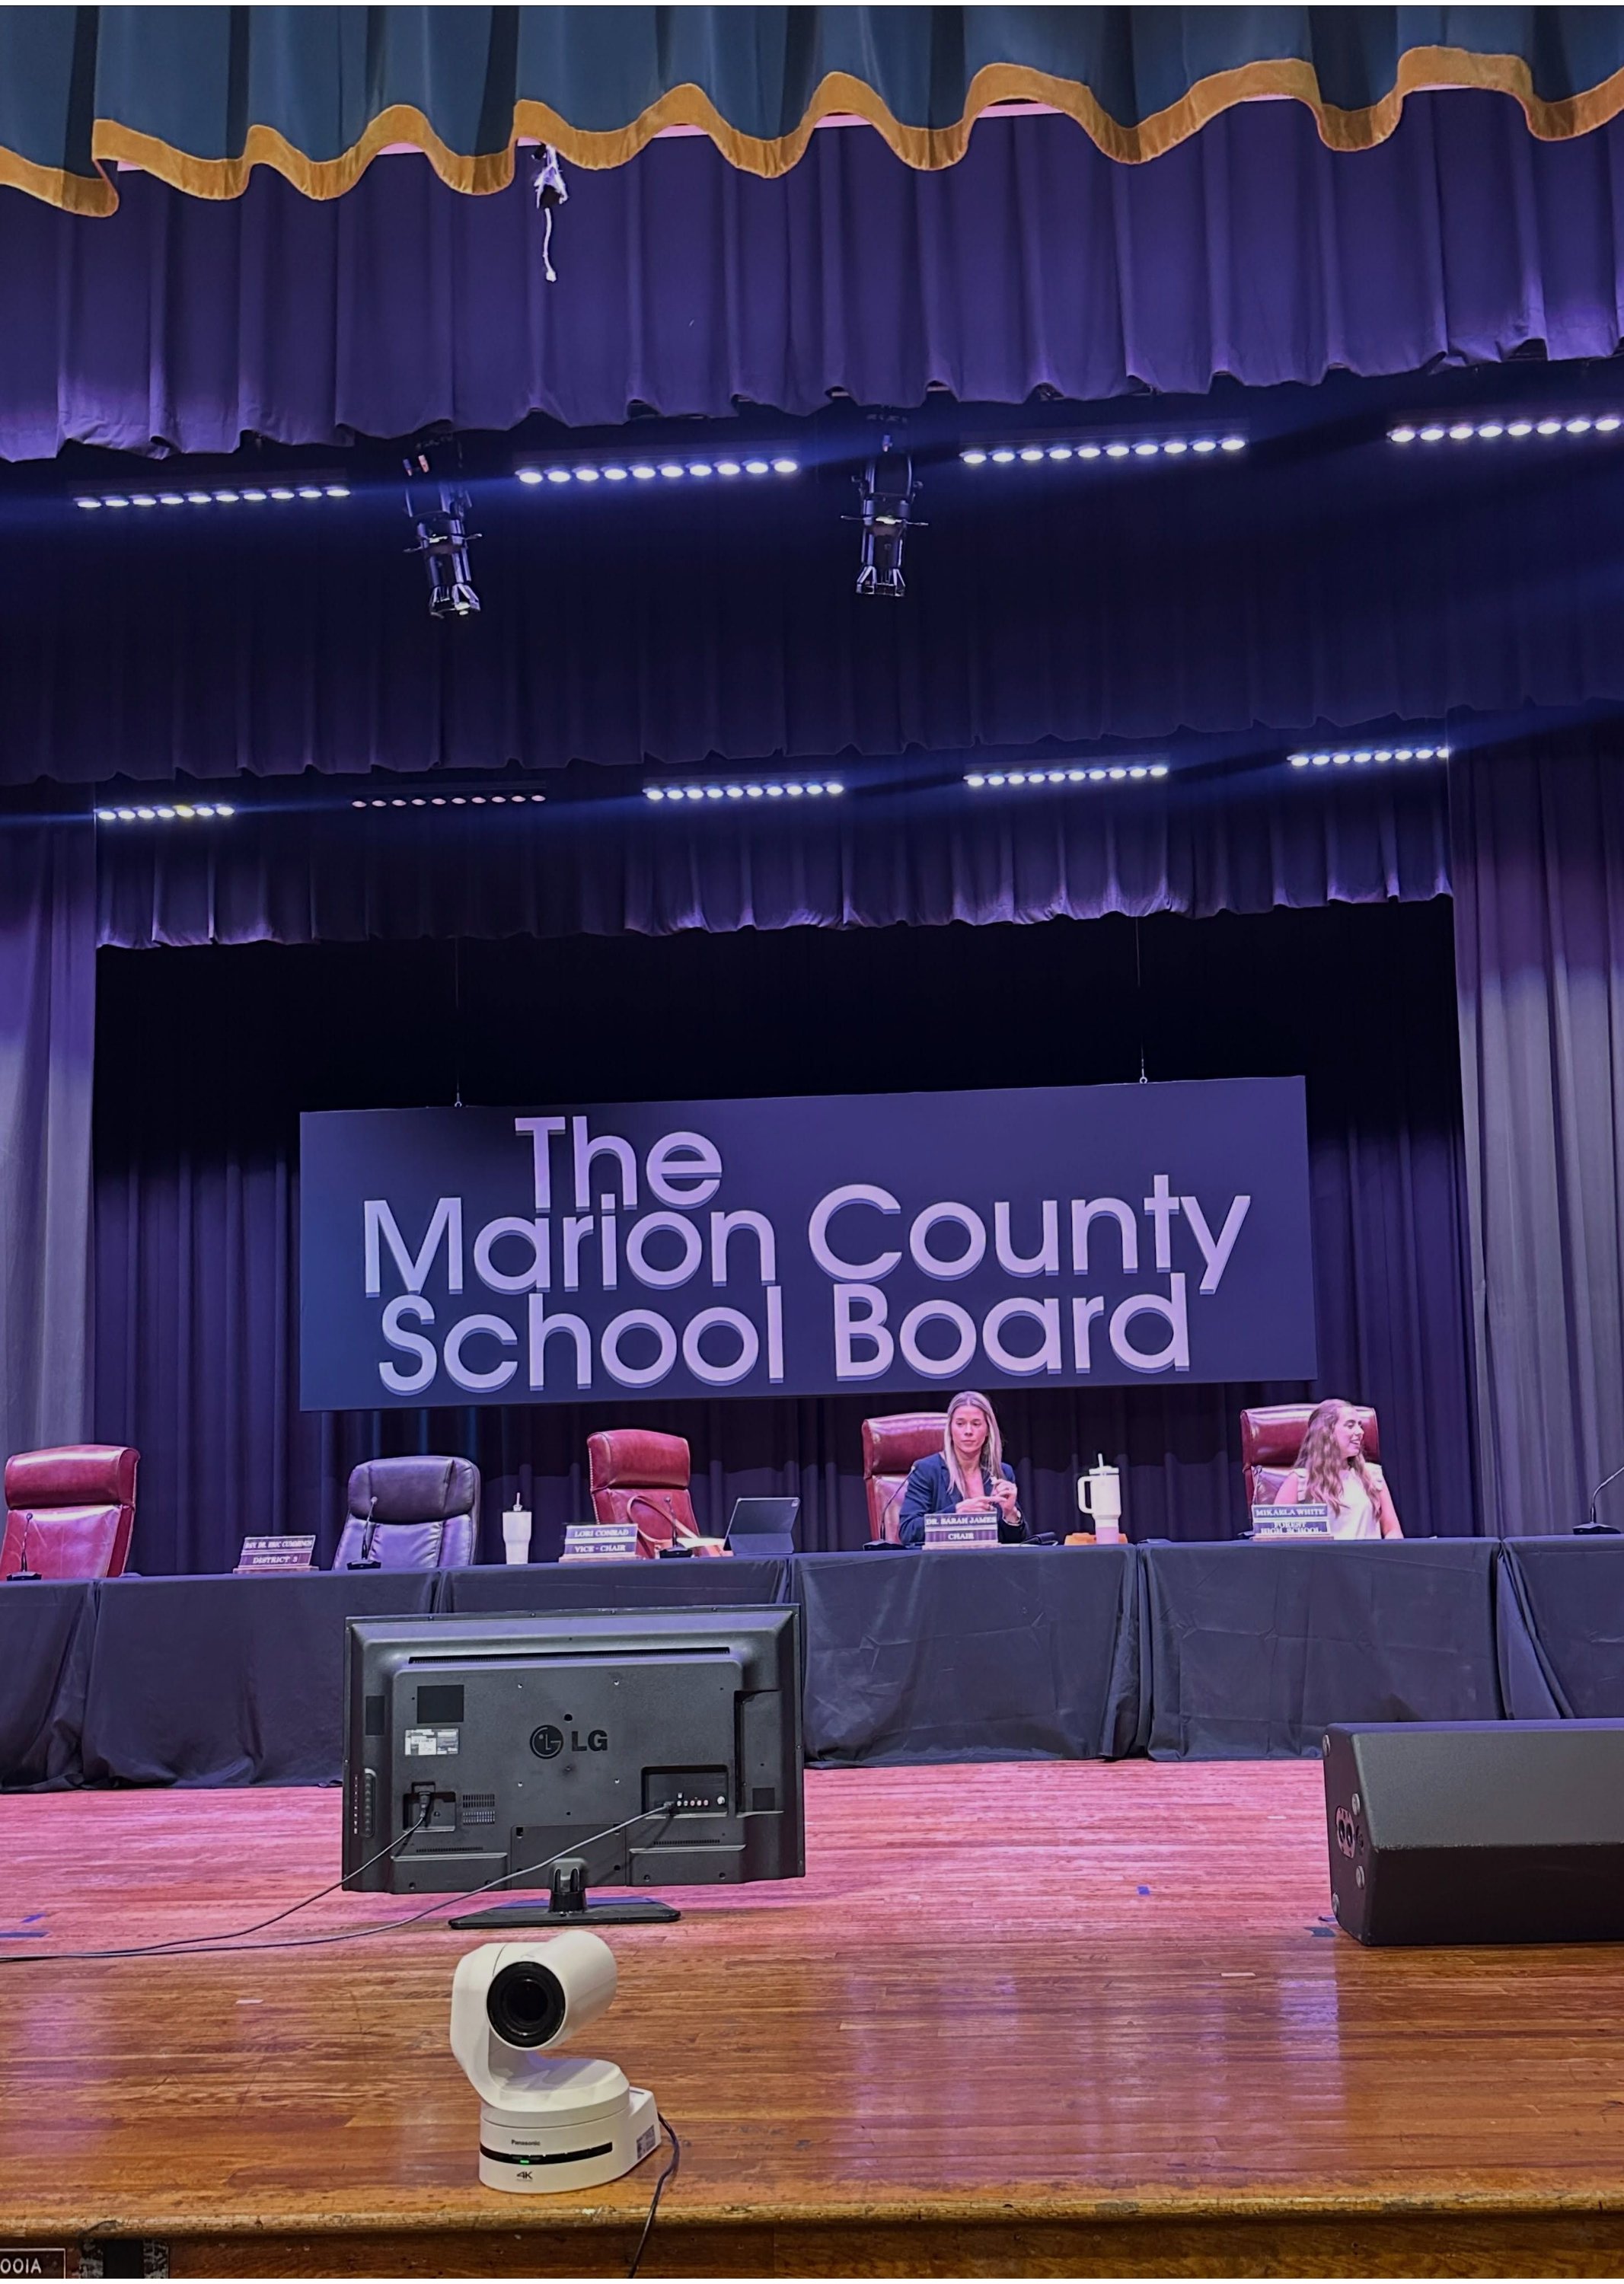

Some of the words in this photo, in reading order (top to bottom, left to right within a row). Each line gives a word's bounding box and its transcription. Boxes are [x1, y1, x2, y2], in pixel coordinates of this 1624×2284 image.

[515, 1116, 722, 1213] The
[364, 1193, 776, 1297] Marion
[809, 1174, 1251, 1295] County
[379, 1285, 784, 1396] School
[834, 1272, 1190, 1381] Board
[595, 1529, 630, 1537] CONRAD
[600, 1544, 627, 1552] CHAIR
[252, 1556, 291, 1565] DISTRICT
[572, 1729, 608, 1752] LG
[516, 2171, 534, 2180] 4K
